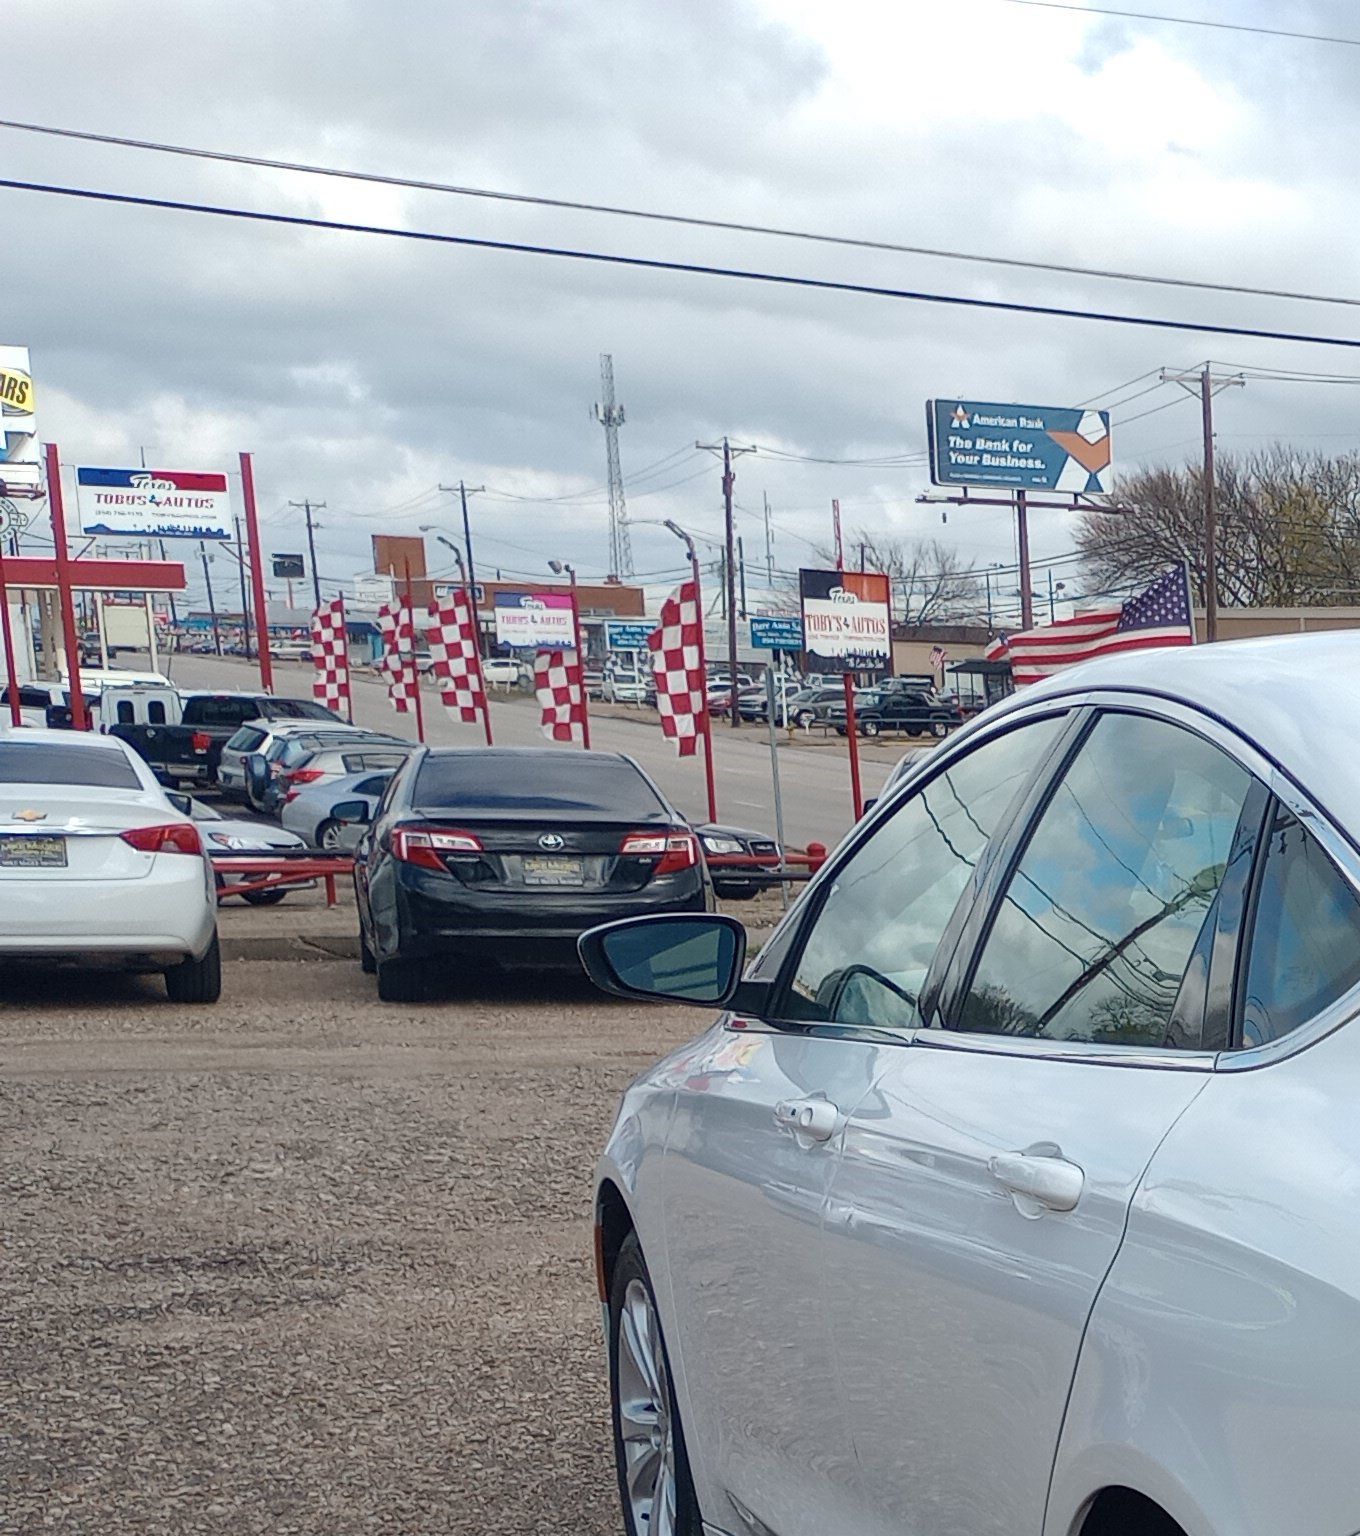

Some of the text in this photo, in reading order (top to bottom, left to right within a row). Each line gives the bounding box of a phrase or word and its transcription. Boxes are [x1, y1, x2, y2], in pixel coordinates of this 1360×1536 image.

[973, 413, 1044, 430] American Bank
[948, 435, 1034, 453] The Bank for
[949, 450, 1046, 470] Your Business.
[800, 614, 842, 632] TOBY'S
[851, 616, 886, 634] AUTOS
